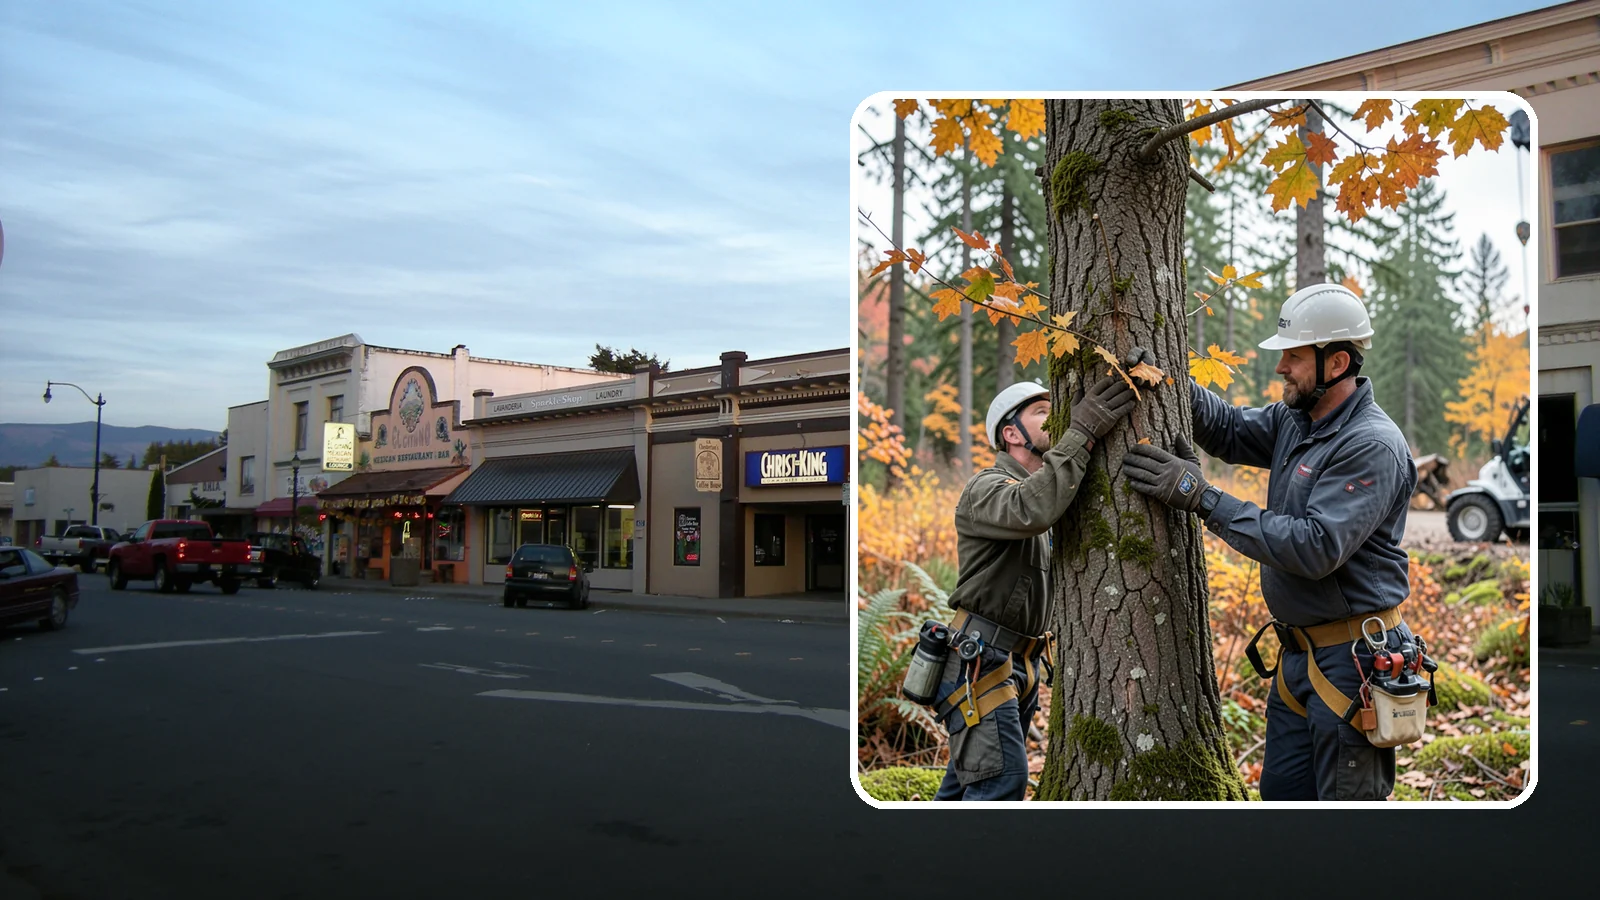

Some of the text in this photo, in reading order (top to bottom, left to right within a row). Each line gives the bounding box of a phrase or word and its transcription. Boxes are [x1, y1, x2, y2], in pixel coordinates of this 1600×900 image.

[493, 402, 523, 412] LAVANDERIA
[562, 394, 582, 404] Shop
[595, 389, 623, 400] LAUNDRY
[373, 455, 396, 464] MEXICAN
[398, 451, 433, 462] RESTAURANT
[438, 450, 450, 459] BAR
[761, 450, 827, 478] CHRIST KING
[697, 481, 709, 489] Coffee
